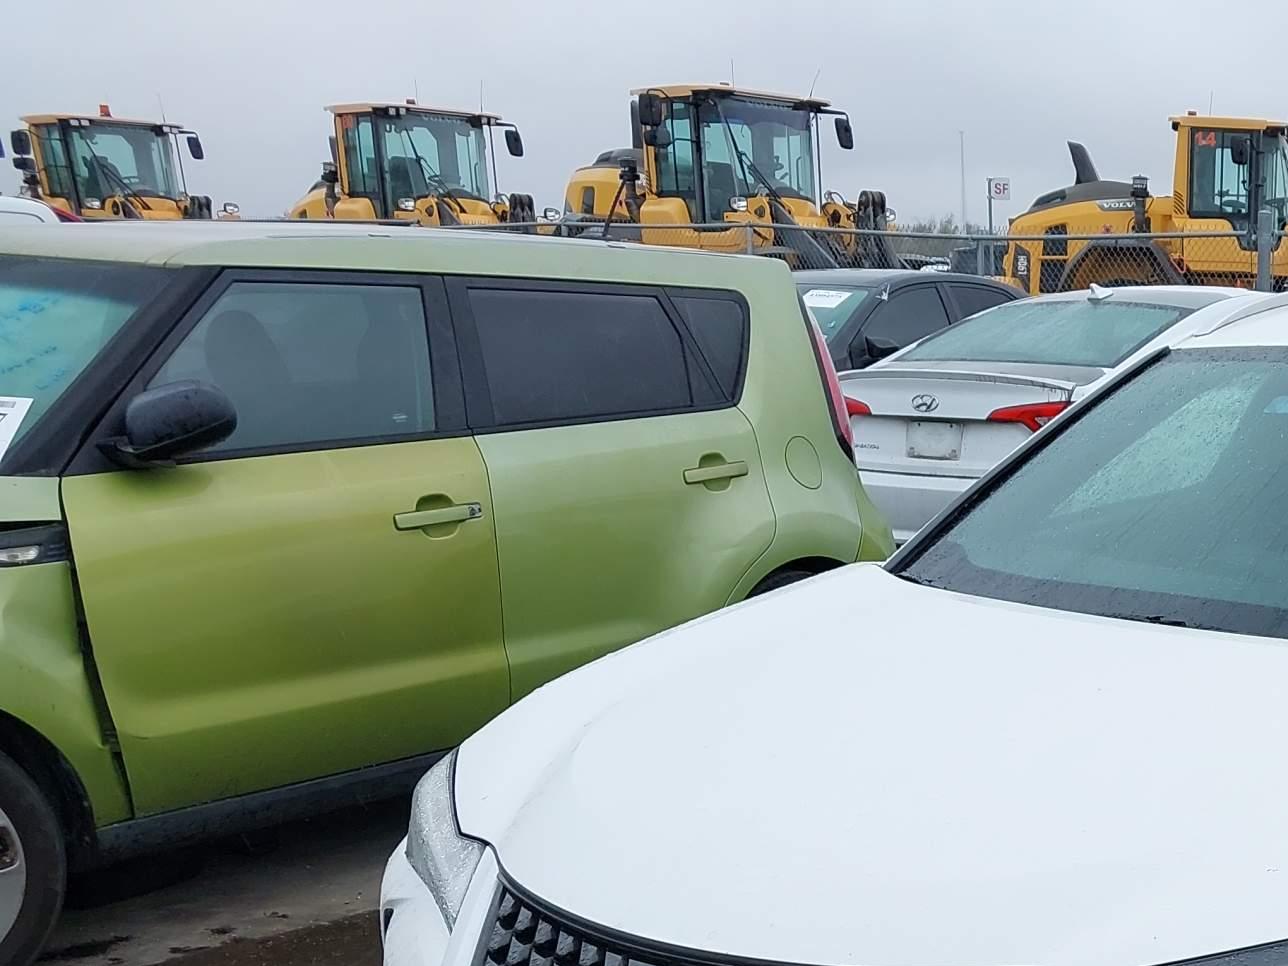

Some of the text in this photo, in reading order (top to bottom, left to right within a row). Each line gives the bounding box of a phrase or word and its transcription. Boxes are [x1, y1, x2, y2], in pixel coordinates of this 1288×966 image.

[1195, 131, 1216, 147] 14
[994, 183, 1009, 195] SF
[1103, 201, 1136, 209] VOLV
